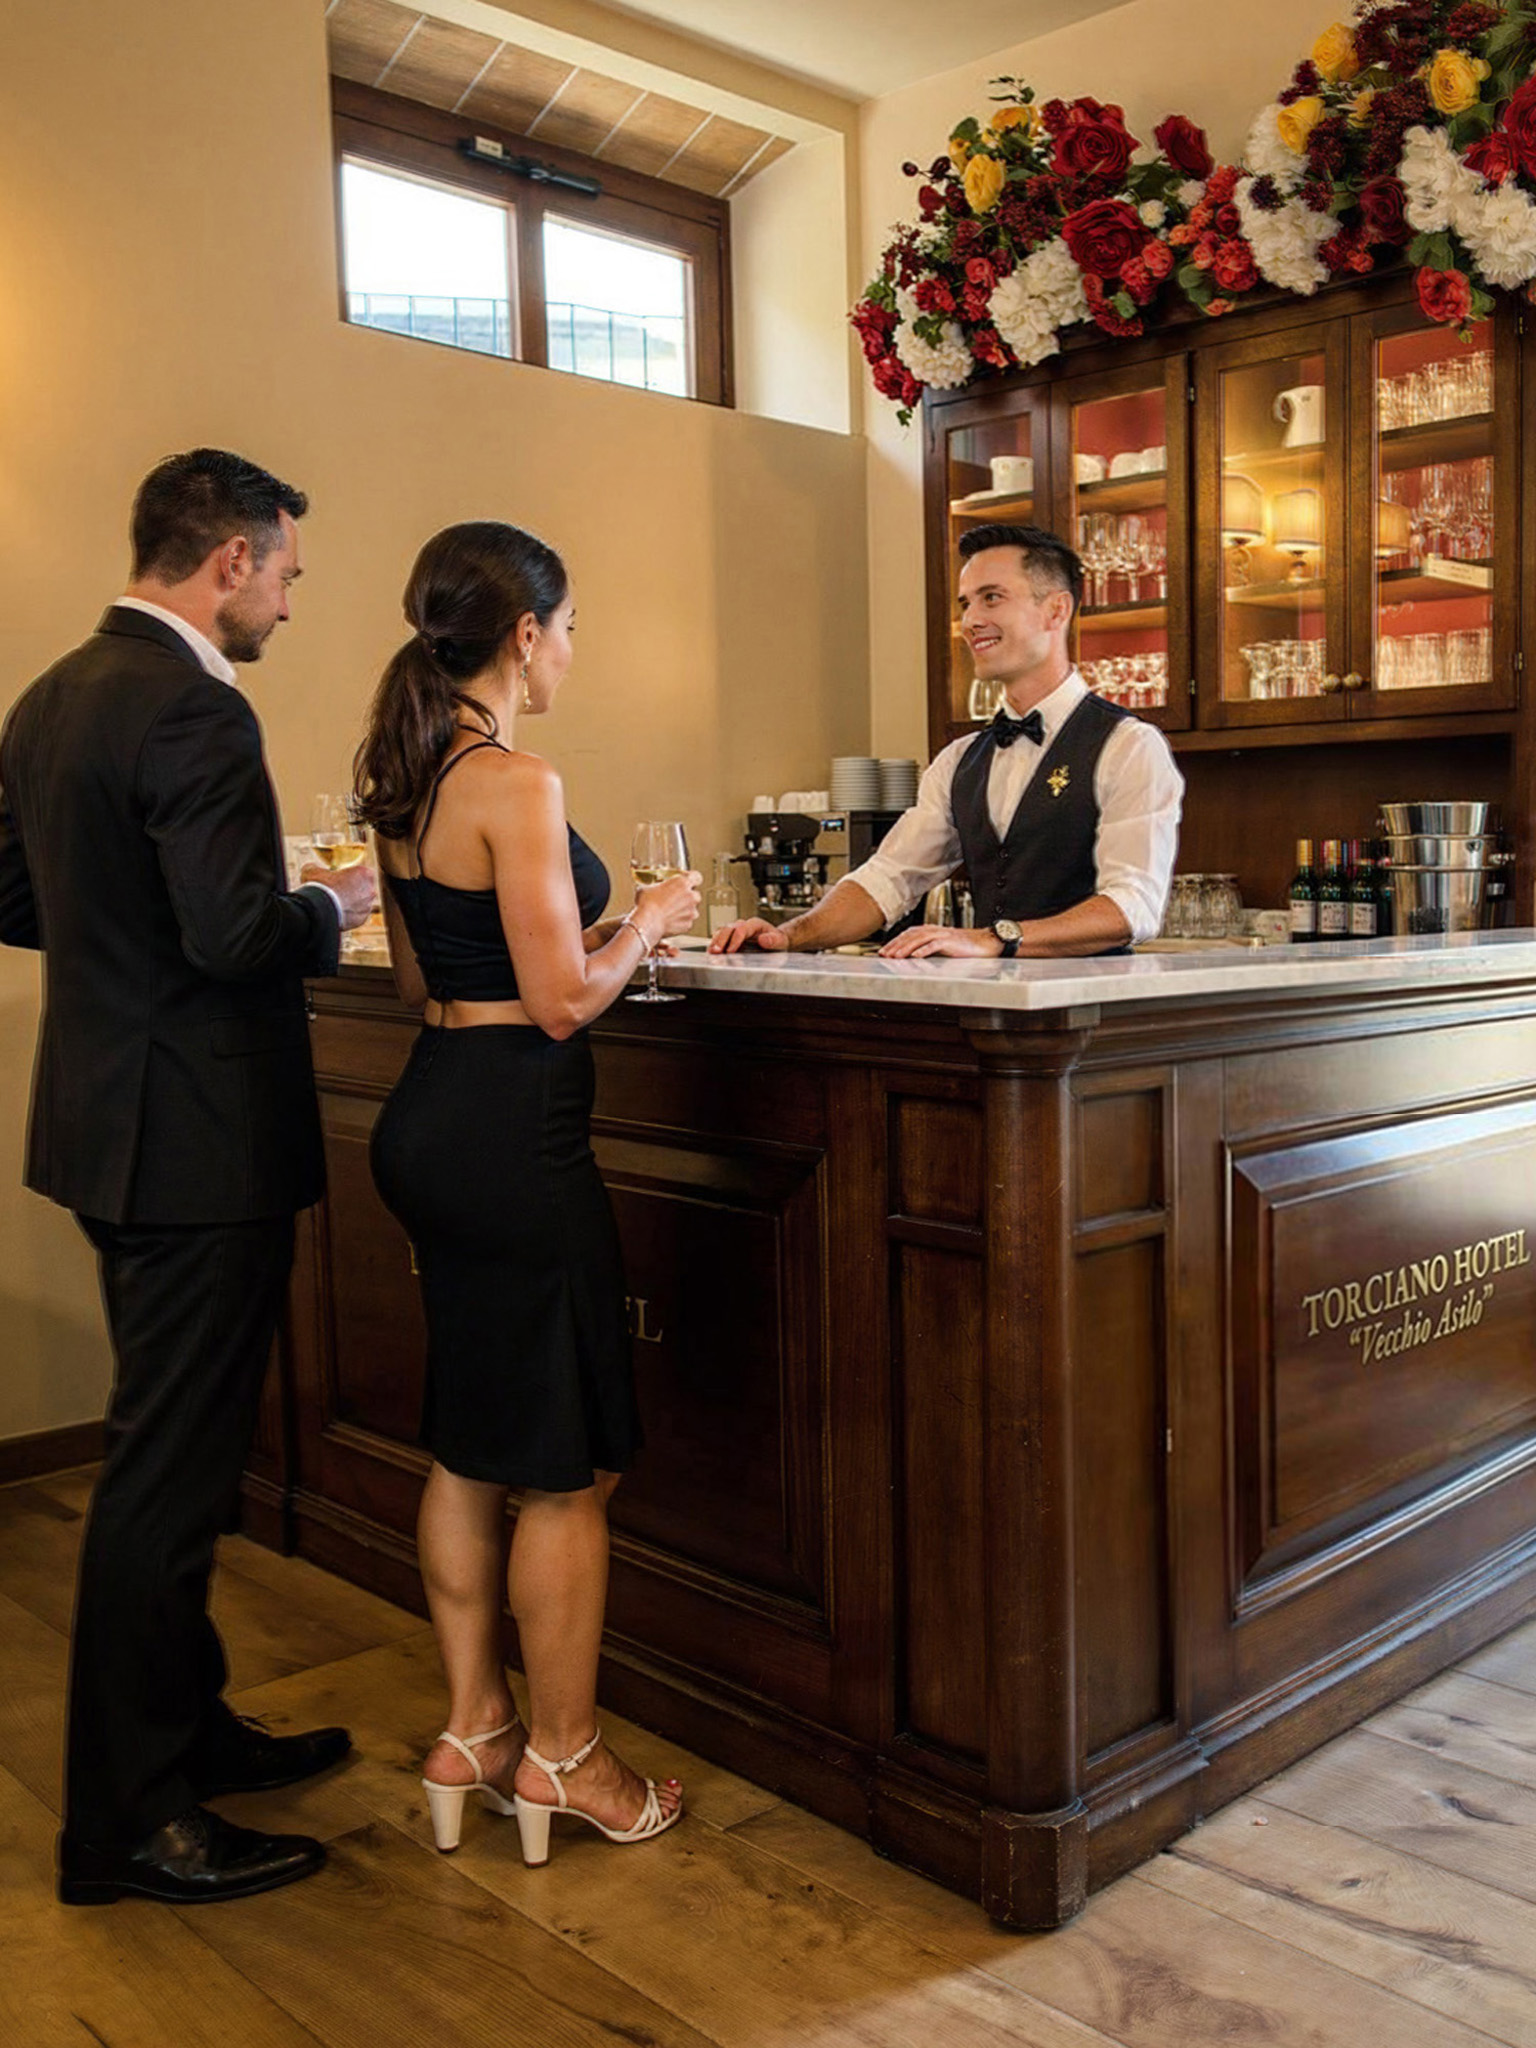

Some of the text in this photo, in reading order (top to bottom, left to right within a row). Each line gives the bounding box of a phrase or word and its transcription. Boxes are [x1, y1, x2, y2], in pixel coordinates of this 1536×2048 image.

[1302, 1228, 1531, 1337] TORCIANO HOTEL
[1349, 1283, 1495, 1365] “Vecchio Asilo”
